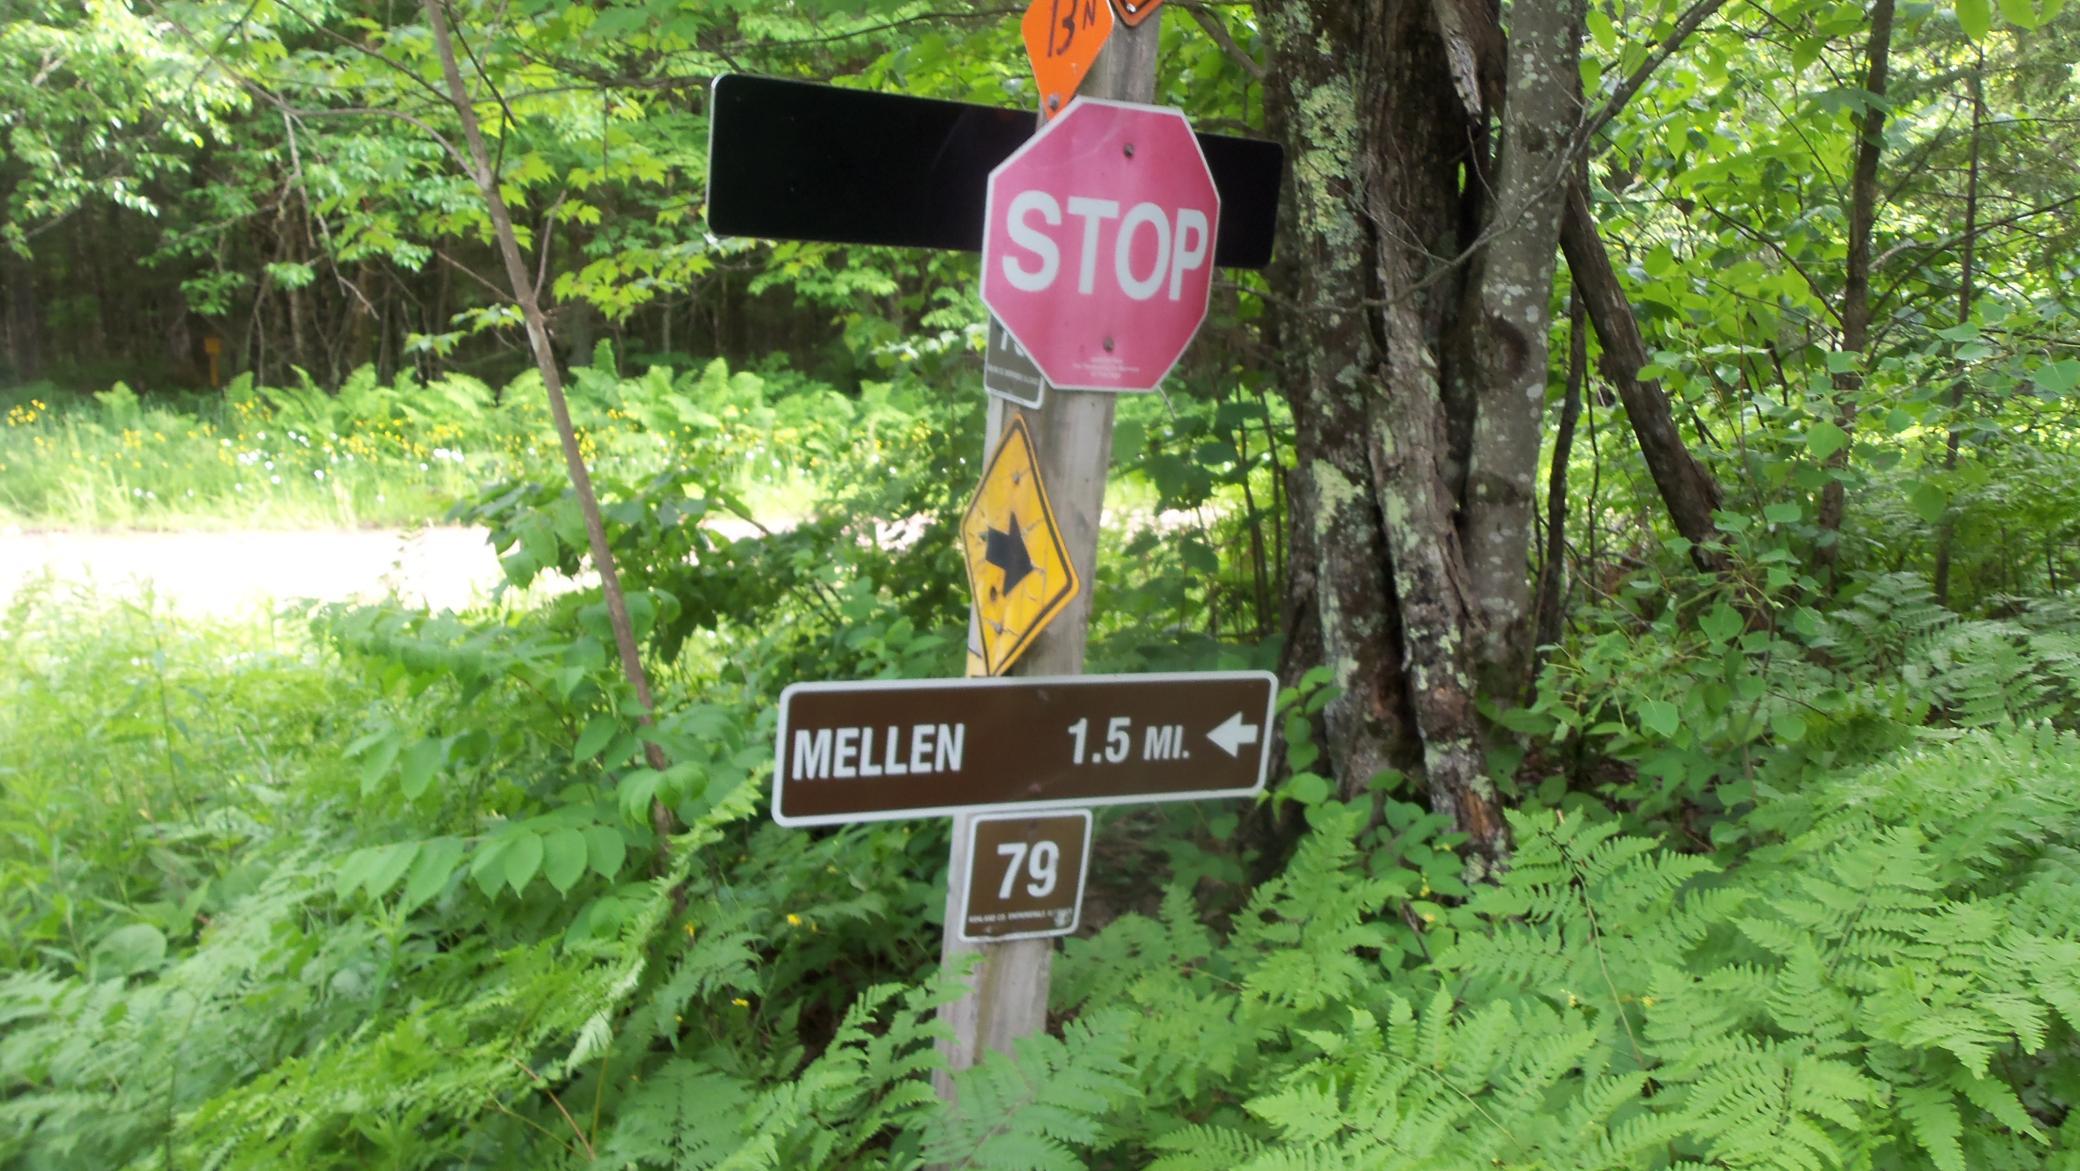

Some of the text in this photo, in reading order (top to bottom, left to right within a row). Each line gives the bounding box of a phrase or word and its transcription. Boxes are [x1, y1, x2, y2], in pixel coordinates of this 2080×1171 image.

[1002, 190, 1209, 301] STOP
[791, 716, 1190, 780] MELLEN 1.5 MI.
[996, 840, 1060, 899] 79
